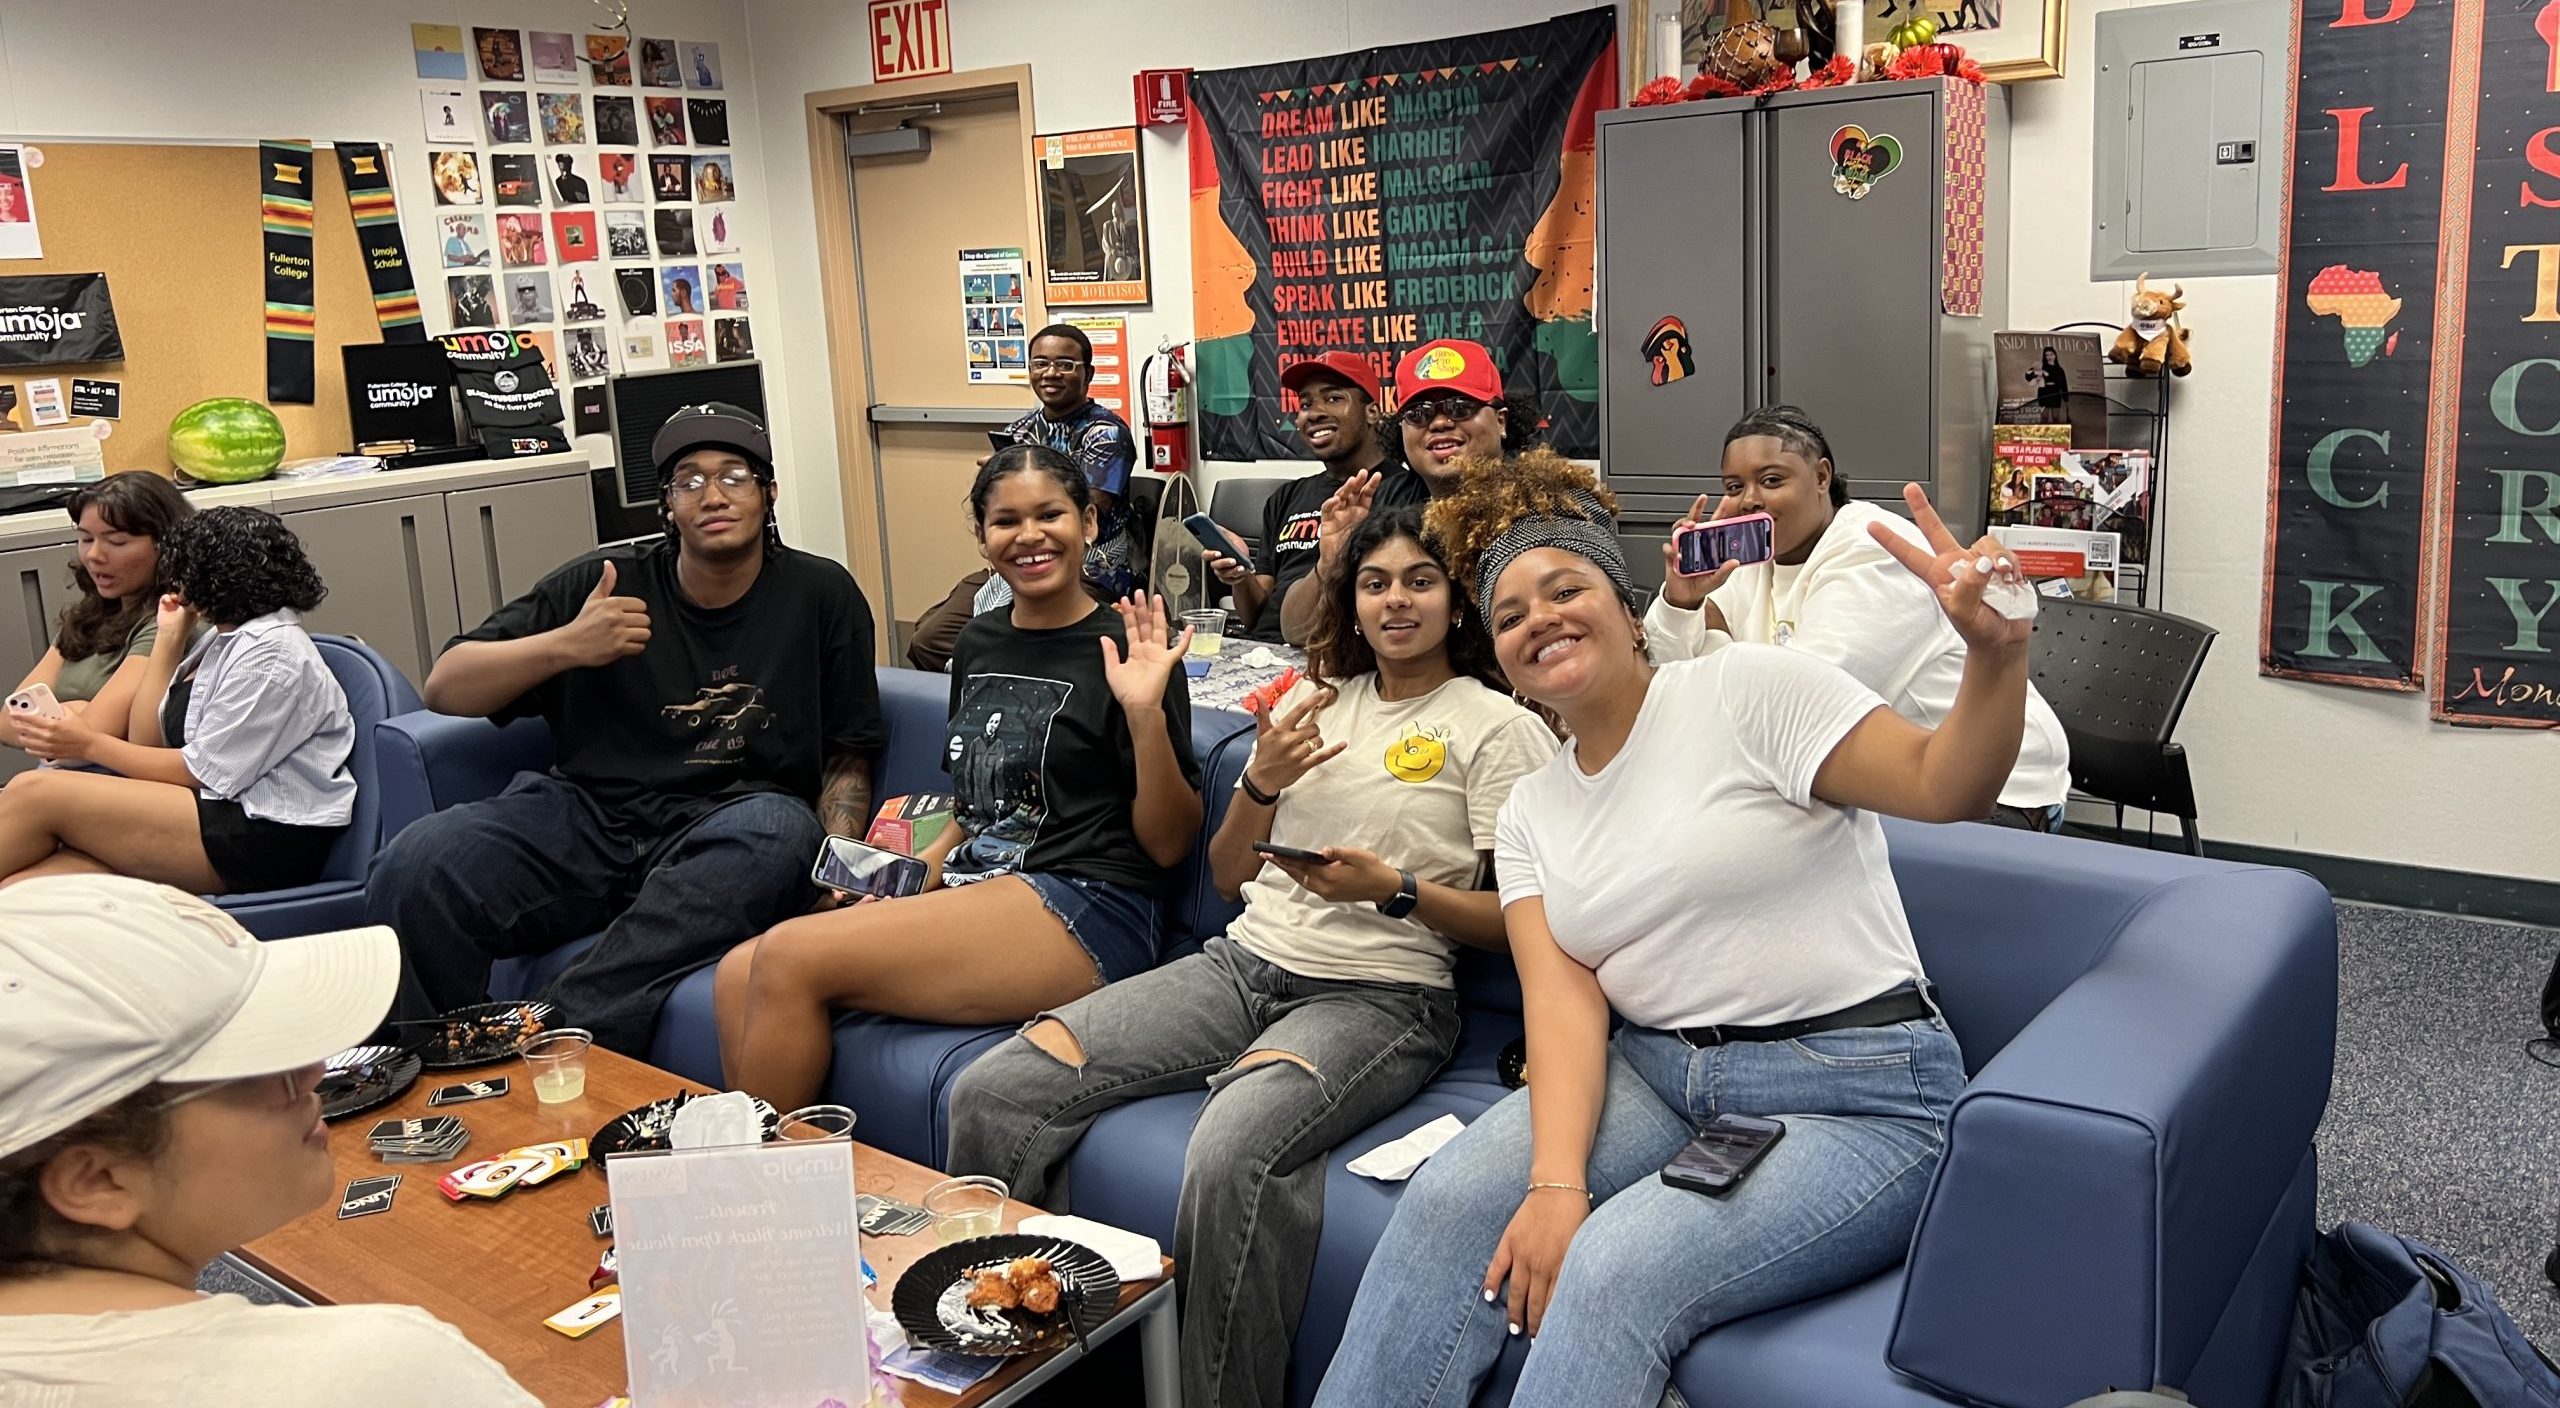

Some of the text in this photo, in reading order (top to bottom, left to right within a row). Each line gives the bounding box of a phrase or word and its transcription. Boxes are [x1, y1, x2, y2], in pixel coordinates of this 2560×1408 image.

[874, 0, 942, 75] EXIT
[1158, 99, 1177, 108] FIRE
[1261, 86, 1479, 140] DREAM LIKE MARTIN
[1262, 125, 1465, 174] LEAD LIKE HARRIET
[1261, 161, 1492, 209] FIGHT LIKE MALCOLM
[1266, 202, 1469, 244] THINK LIKE GARVEY
[269, 252, 310, 267] Fullerton
[372, 247, 398, 258] Umoja
[1272, 249, 1327, 278] BUILD
[1334, 244, 1382, 275] LIKE
[1388, 238, 1471, 272] MADAM
[373, 258, 403, 270] Scholar
[274, 265, 308, 280] College
[1048, 283, 1144, 298] TONI MORRISON
[1274, 271, 1515, 313] SPEAK LIKE FREDERICK
[0, 332, 50, 342] ommunity
[1277, 317, 1366, 346] EDUCATE
[1373, 314, 1417, 343] LIKE
[438, 330, 536, 358] umoja
[669, 339, 705, 354] ISSA
[446, 351, 506, 360] community
[368, 382, 433, 406] umoja
[370, 400, 411, 409] community
[8, 443, 79, 455] Positive Affirmations
[1999, 446, 2021, 454] THERE'S
[2025, 446, 2042, 454] PLACE
[2452, 666, 2560, 706] Mon
[468, 1081, 493, 1095] UNO
[406, 1118, 423, 1135] UNO
[344, 1191, 390, 1211] UNO
